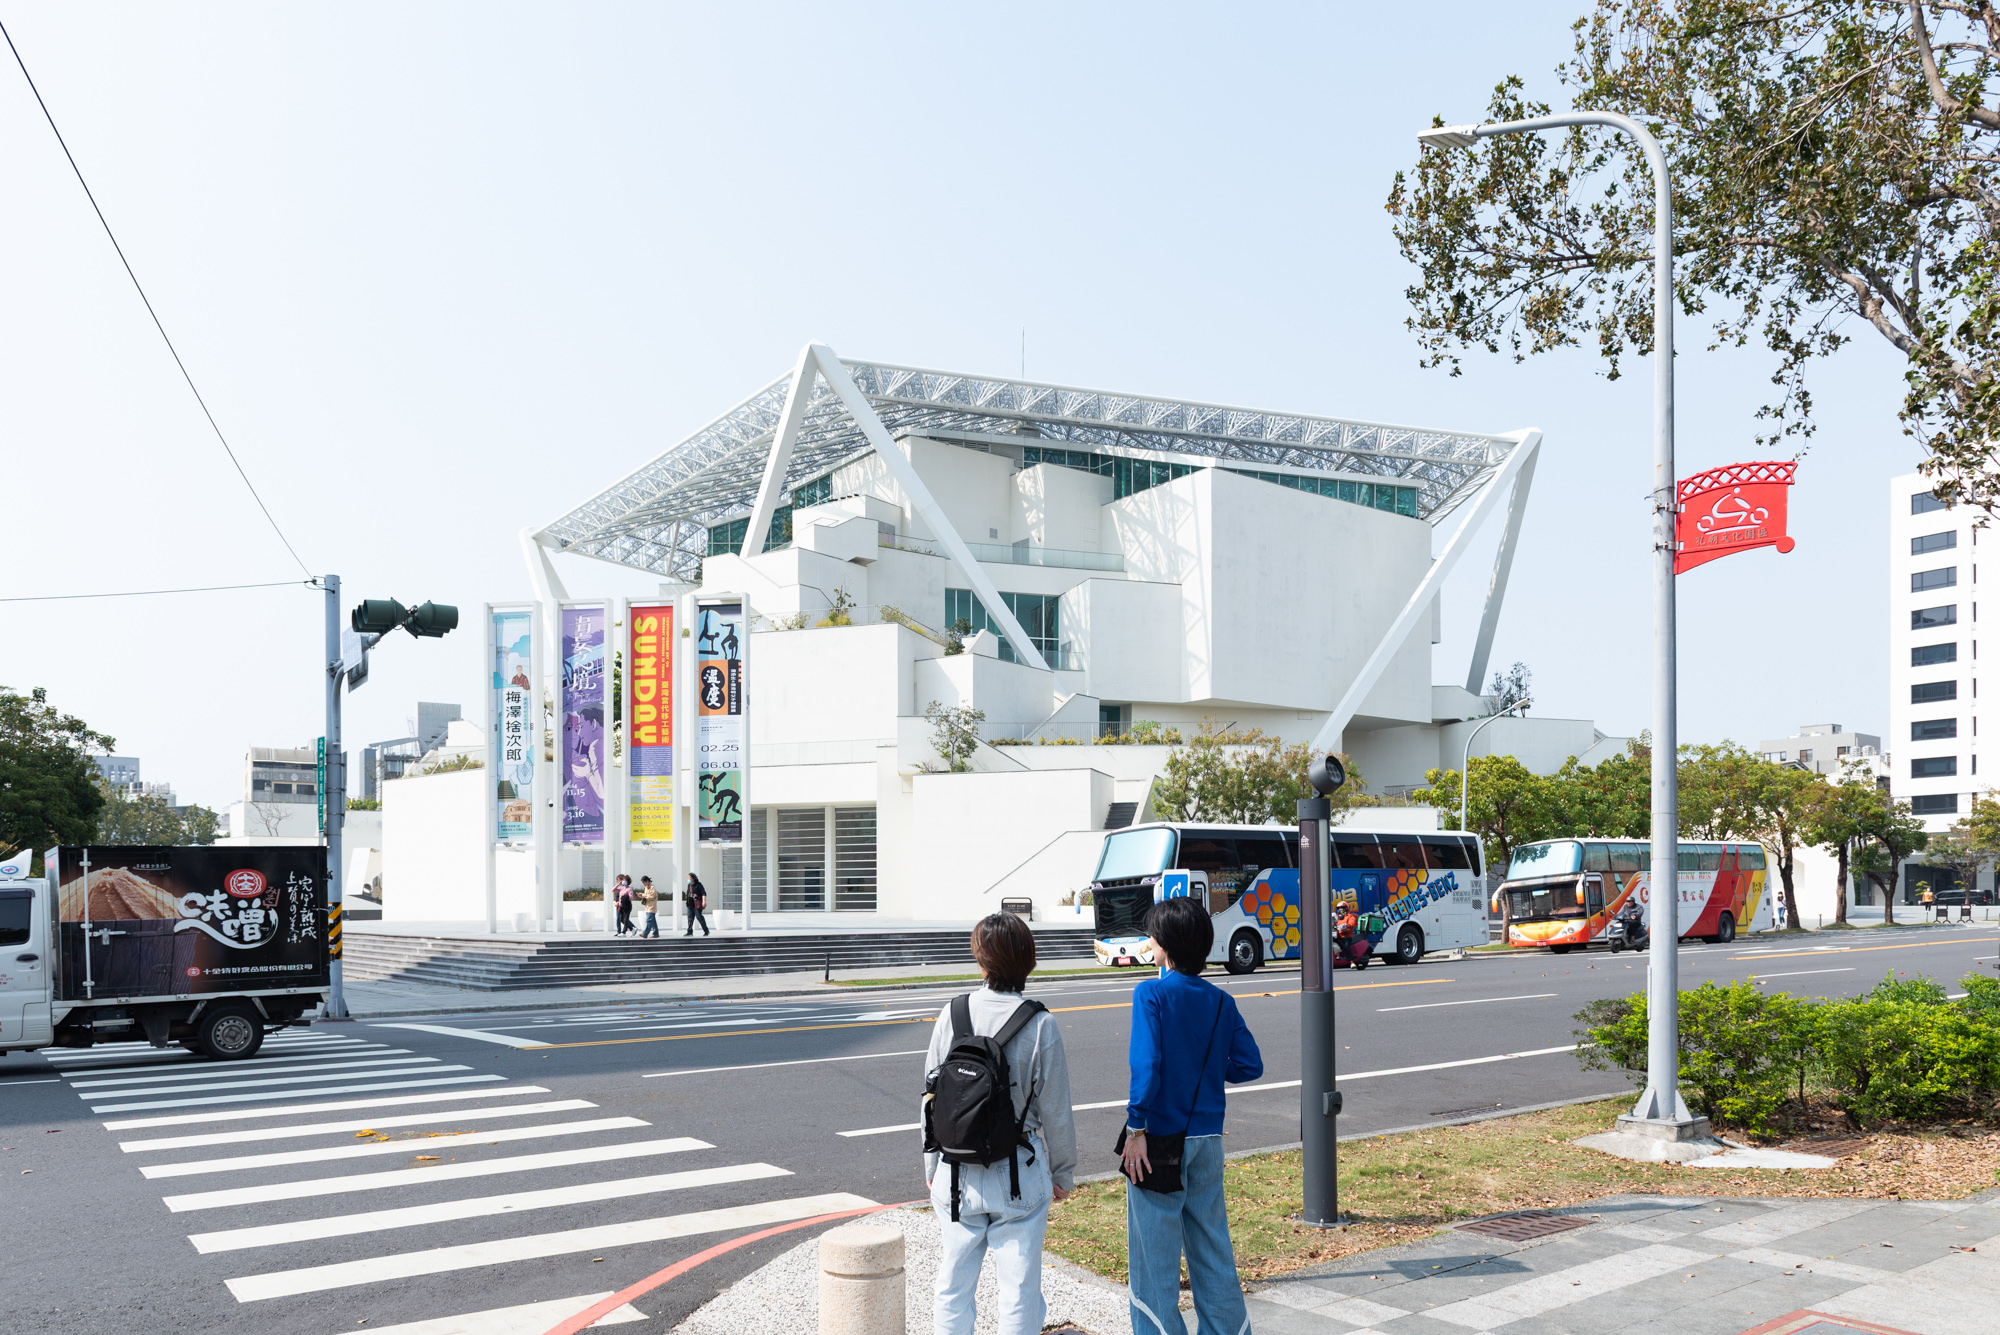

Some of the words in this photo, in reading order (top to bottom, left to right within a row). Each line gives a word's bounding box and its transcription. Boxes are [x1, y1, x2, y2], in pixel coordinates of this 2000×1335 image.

[634, 616, 658, 744] SUNDAY
[506, 691, 522, 761] 梅澤捨次郎
[661, 681, 670, 744] 臺灣當代移工藝術
[567, 789, 585, 797] 11.15
[568, 809, 585, 820] 3.16
[178, 889, 266, 941] 味噌
[1380, 871, 1459, 928] RCEDES-BENZ
